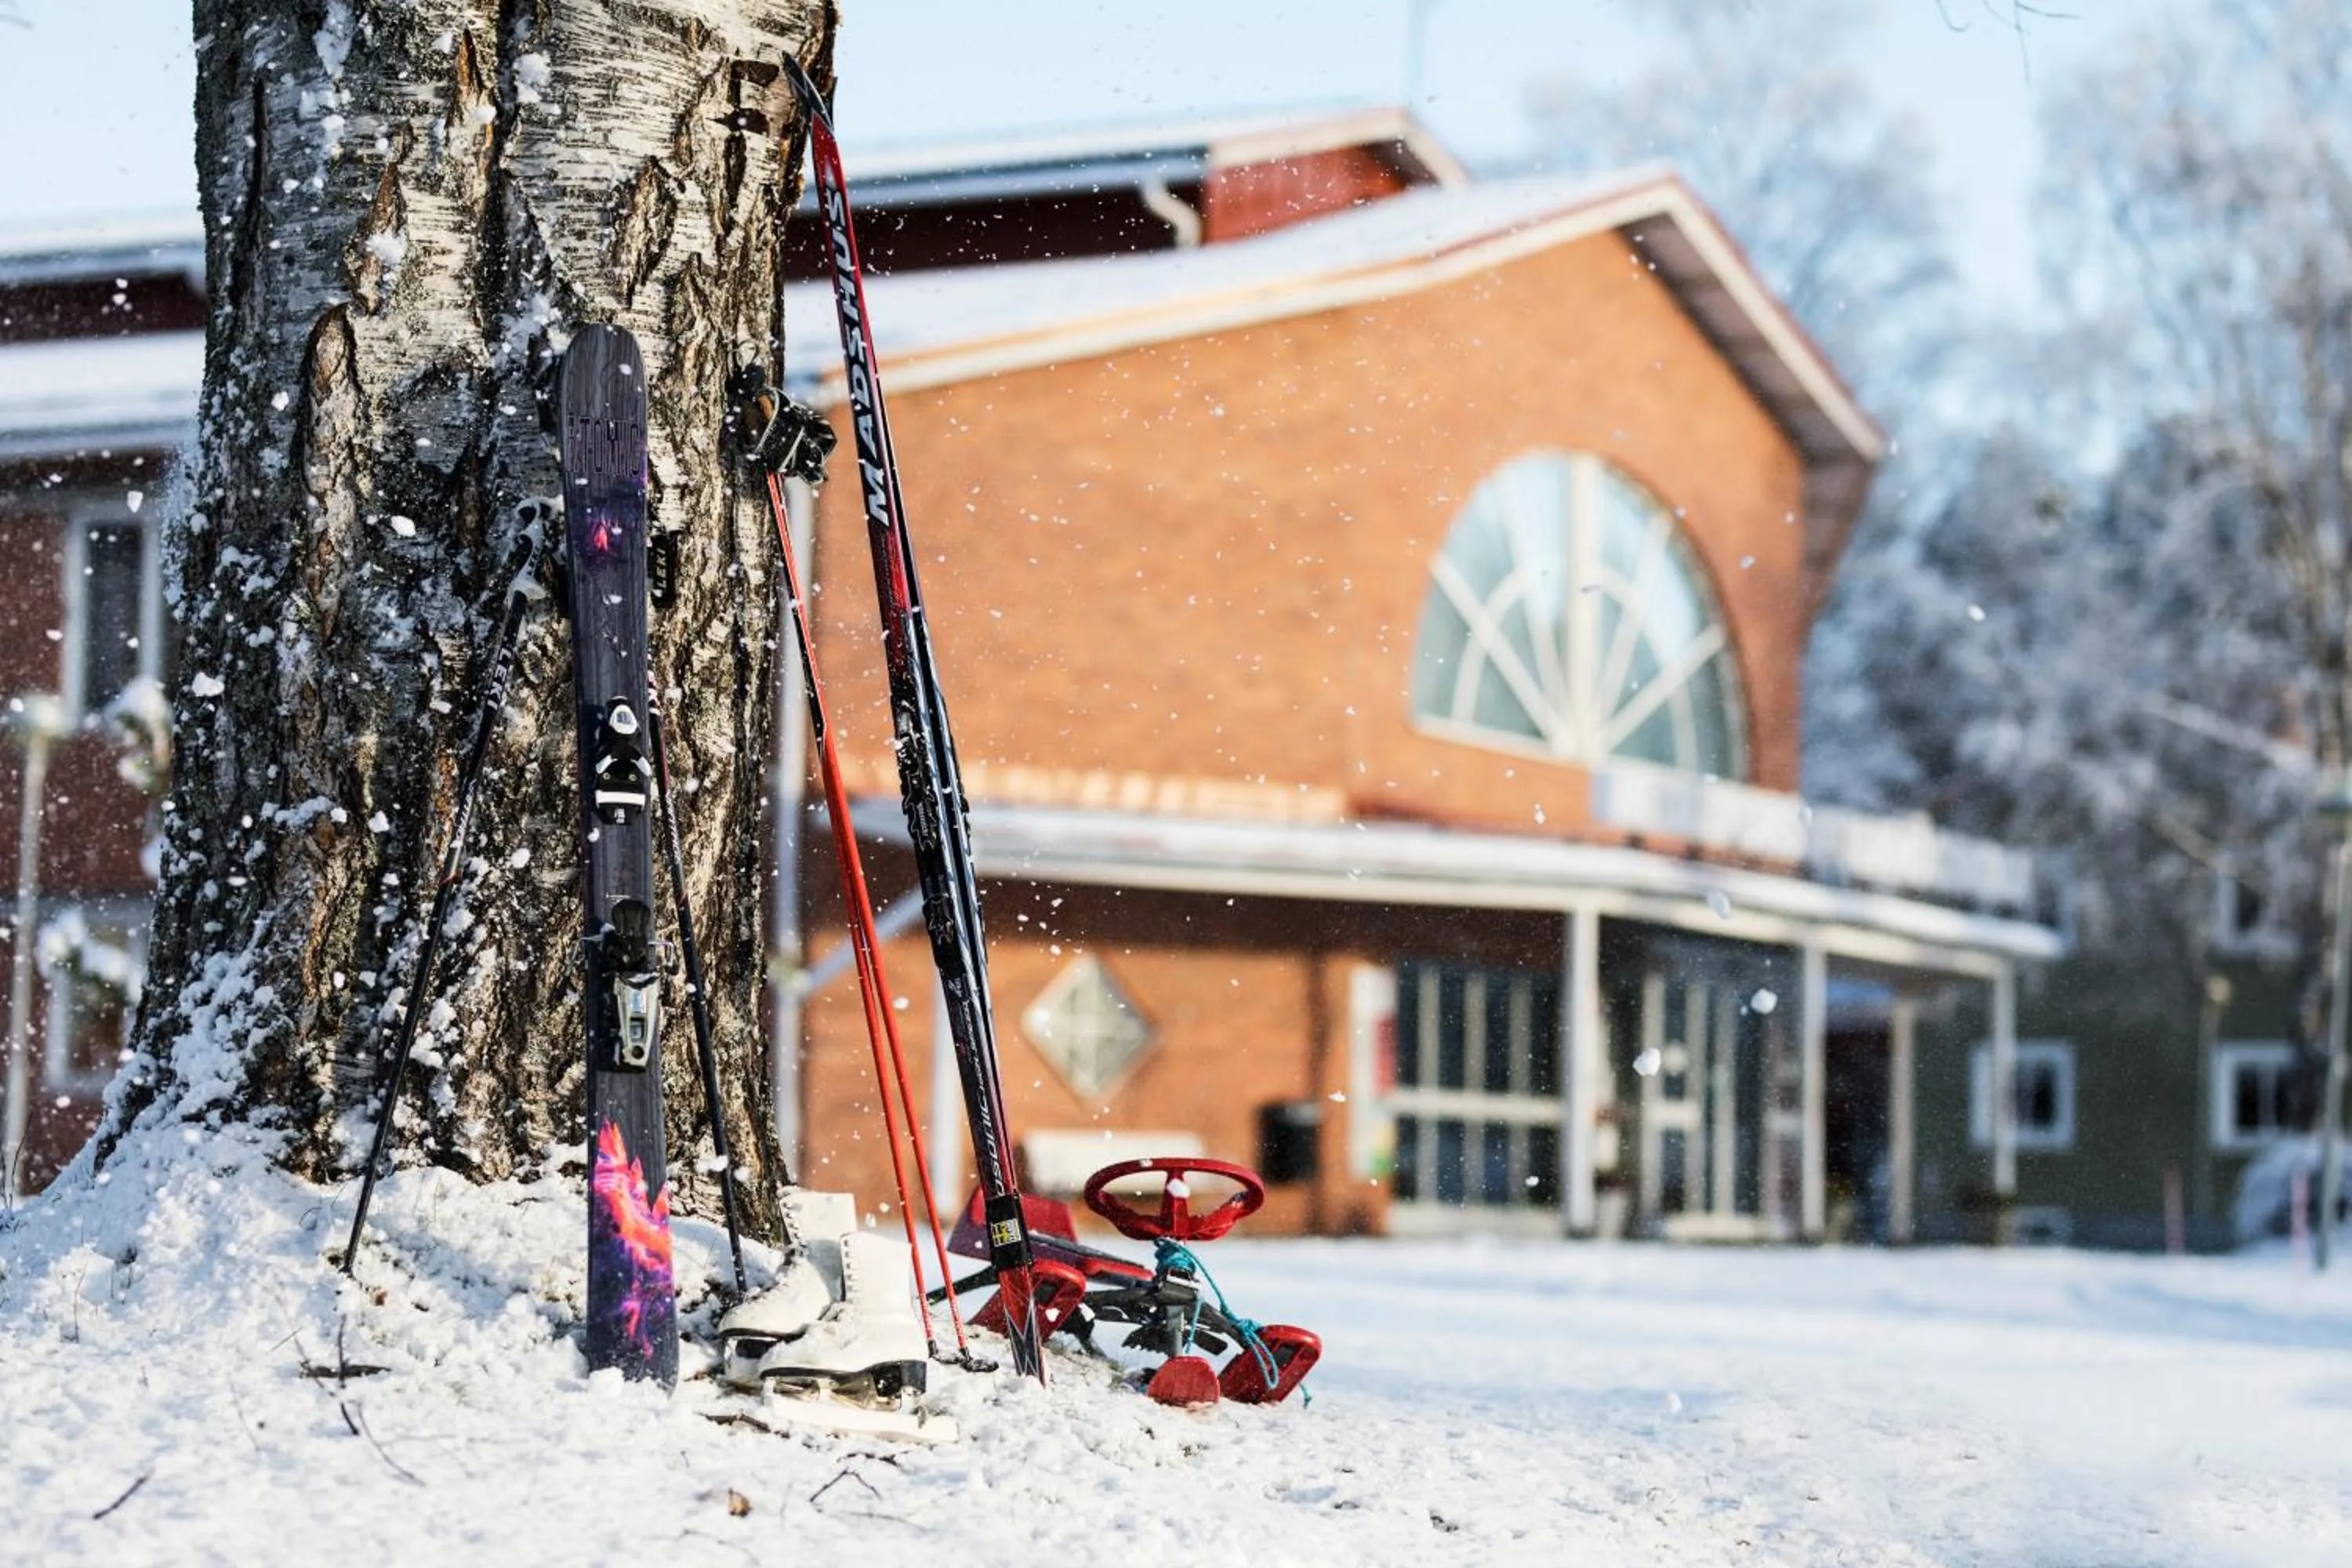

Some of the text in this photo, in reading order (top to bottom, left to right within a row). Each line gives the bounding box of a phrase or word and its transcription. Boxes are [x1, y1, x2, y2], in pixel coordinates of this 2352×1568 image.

[826, 187, 890, 526] MADSHUS
[565, 414, 641, 477] ATOMIC
[656, 548, 666, 589] LEKI
[487, 648, 512, 710] LEKI
